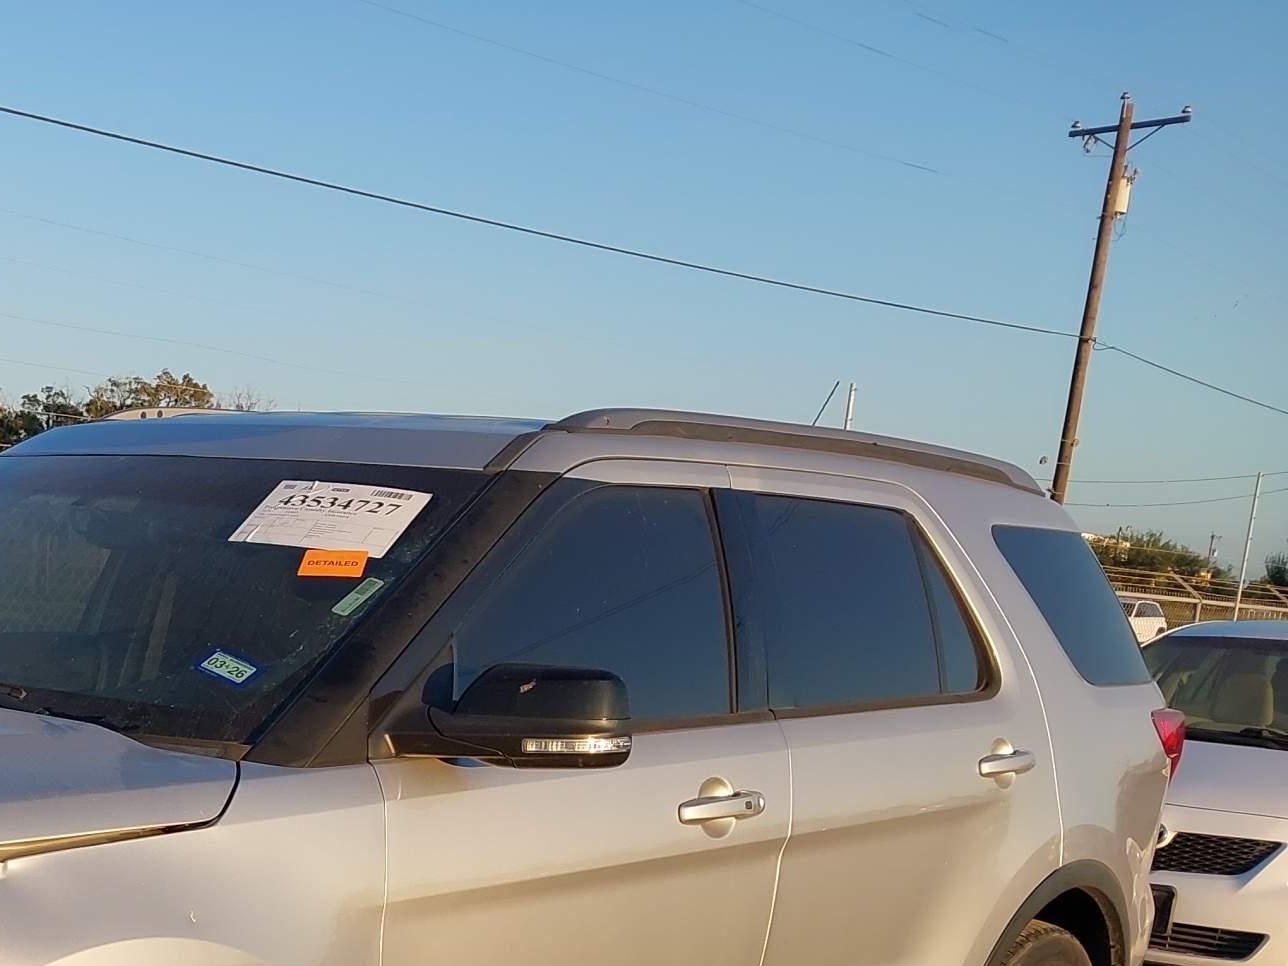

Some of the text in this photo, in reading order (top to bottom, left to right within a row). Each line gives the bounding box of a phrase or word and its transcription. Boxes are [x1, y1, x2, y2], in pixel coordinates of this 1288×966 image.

[278, 494, 402, 516] 43534727
[207, 657, 226, 668] 03
[227, 666, 247, 678] 26
